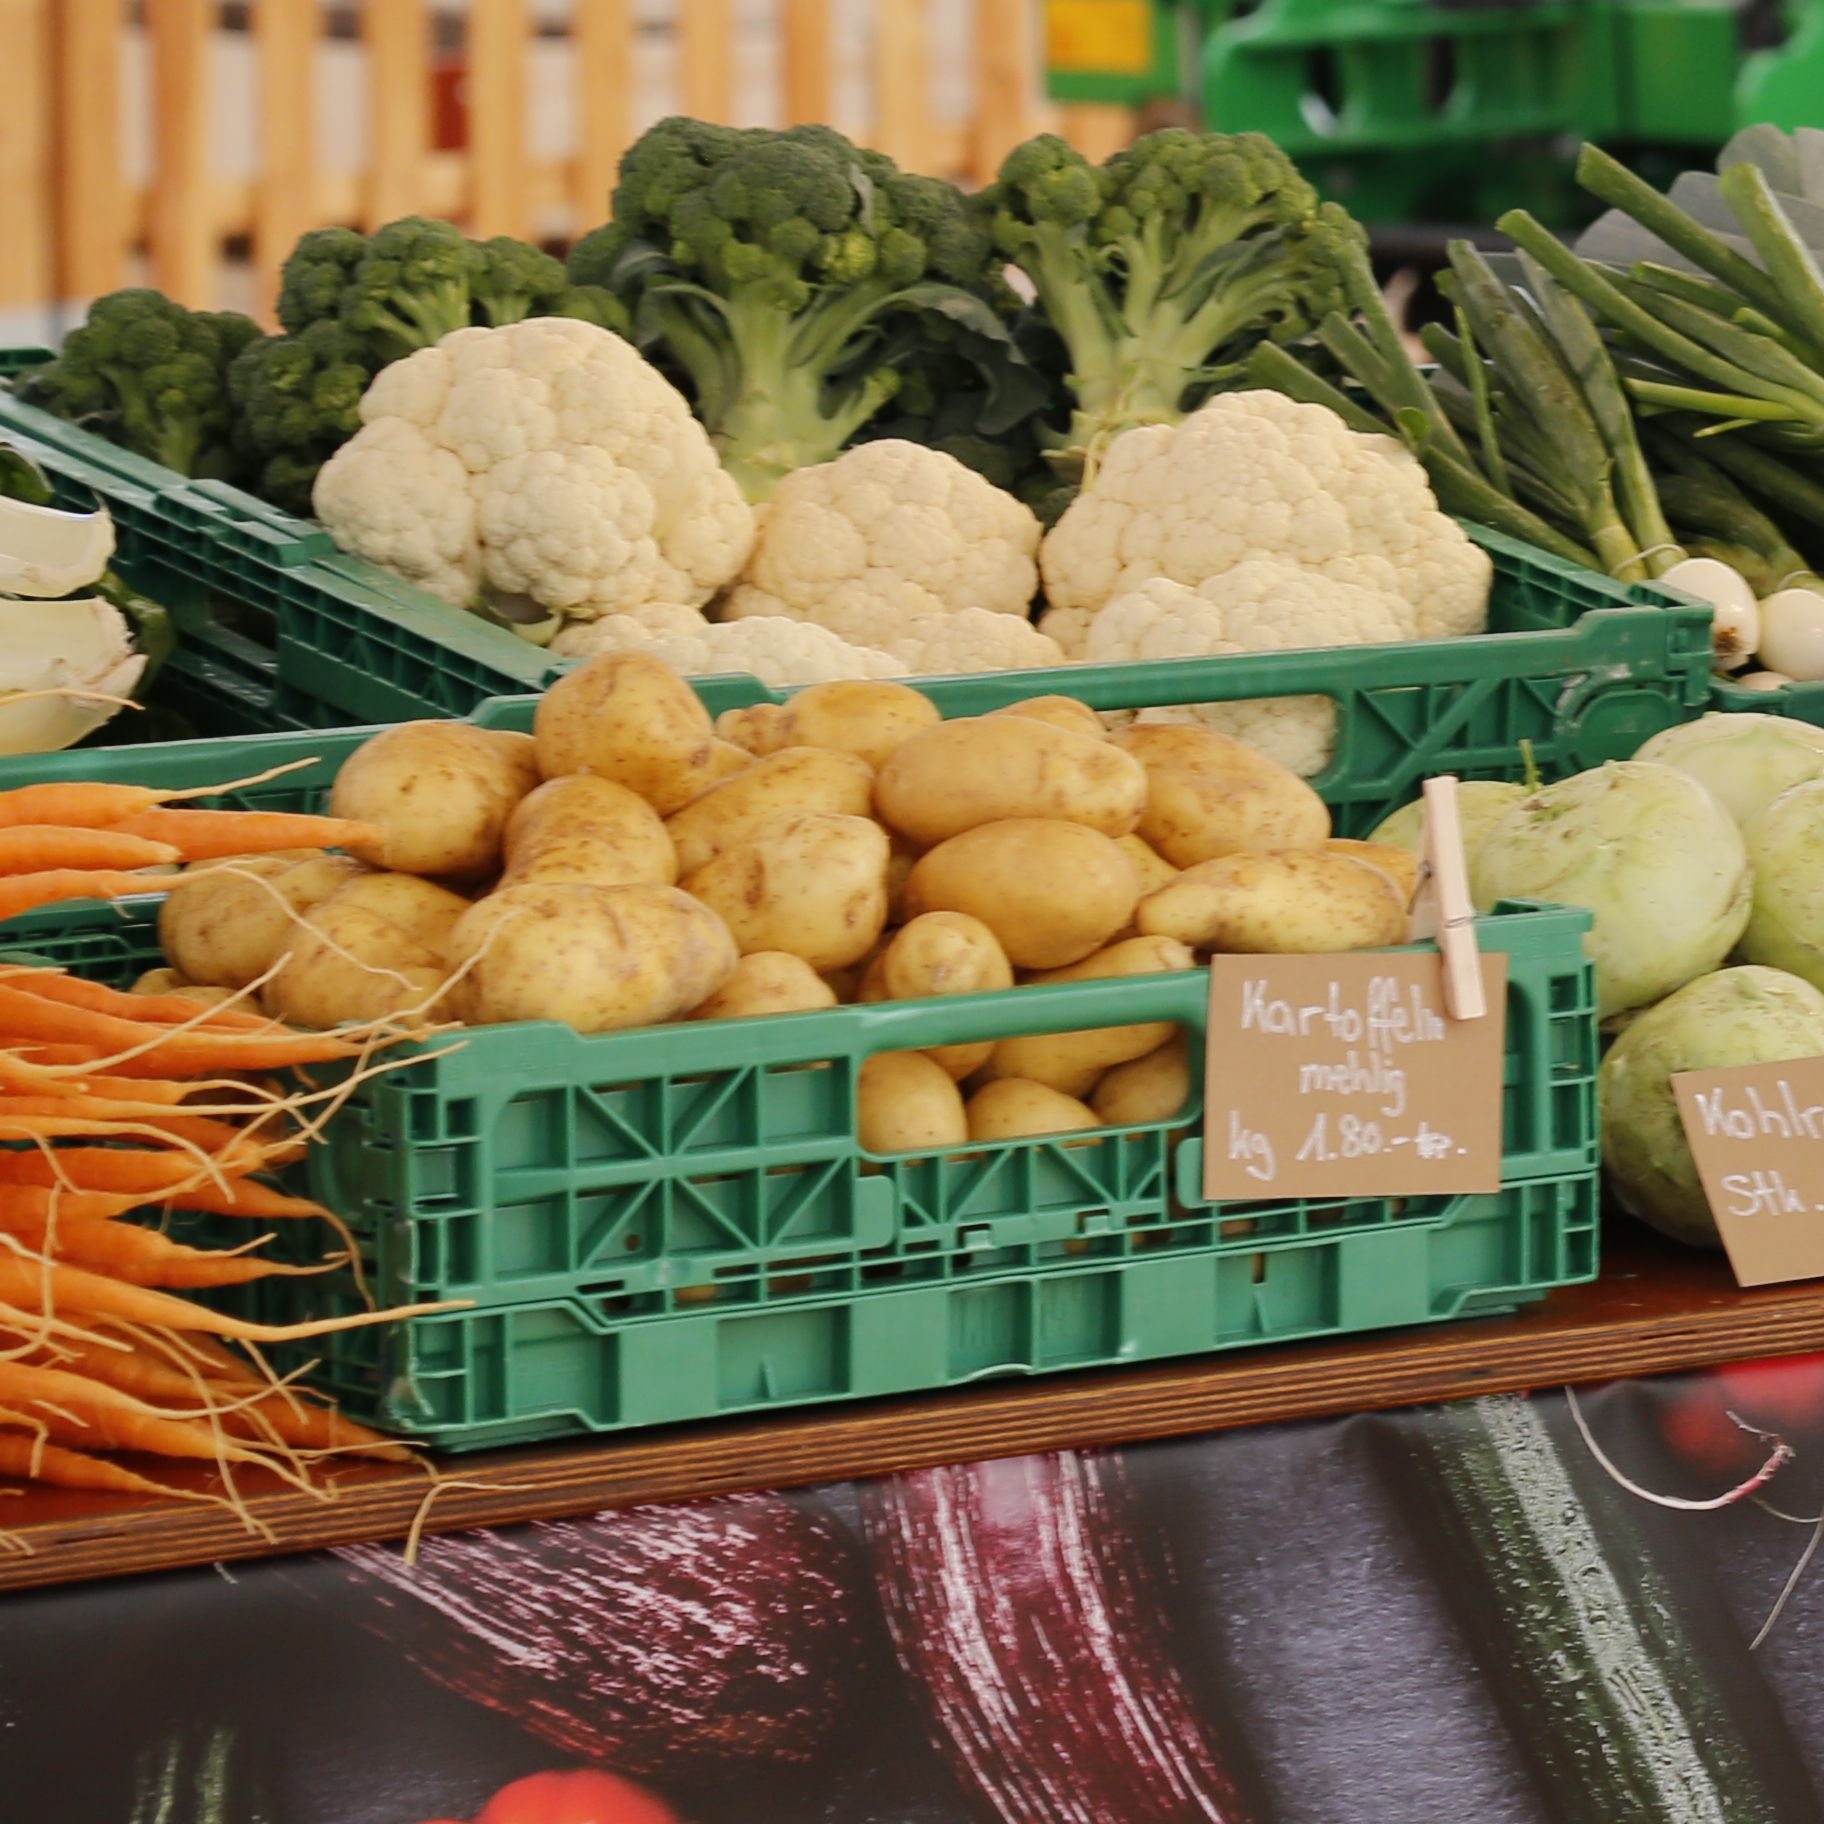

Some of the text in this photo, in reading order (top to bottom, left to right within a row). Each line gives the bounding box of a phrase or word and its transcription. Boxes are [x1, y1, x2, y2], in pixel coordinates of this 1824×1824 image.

[1241, 976, 1446, 1054] Kartoffeln
[1300, 1050, 1408, 1117] mehlig
[1228, 1110, 1276, 1181] kg
